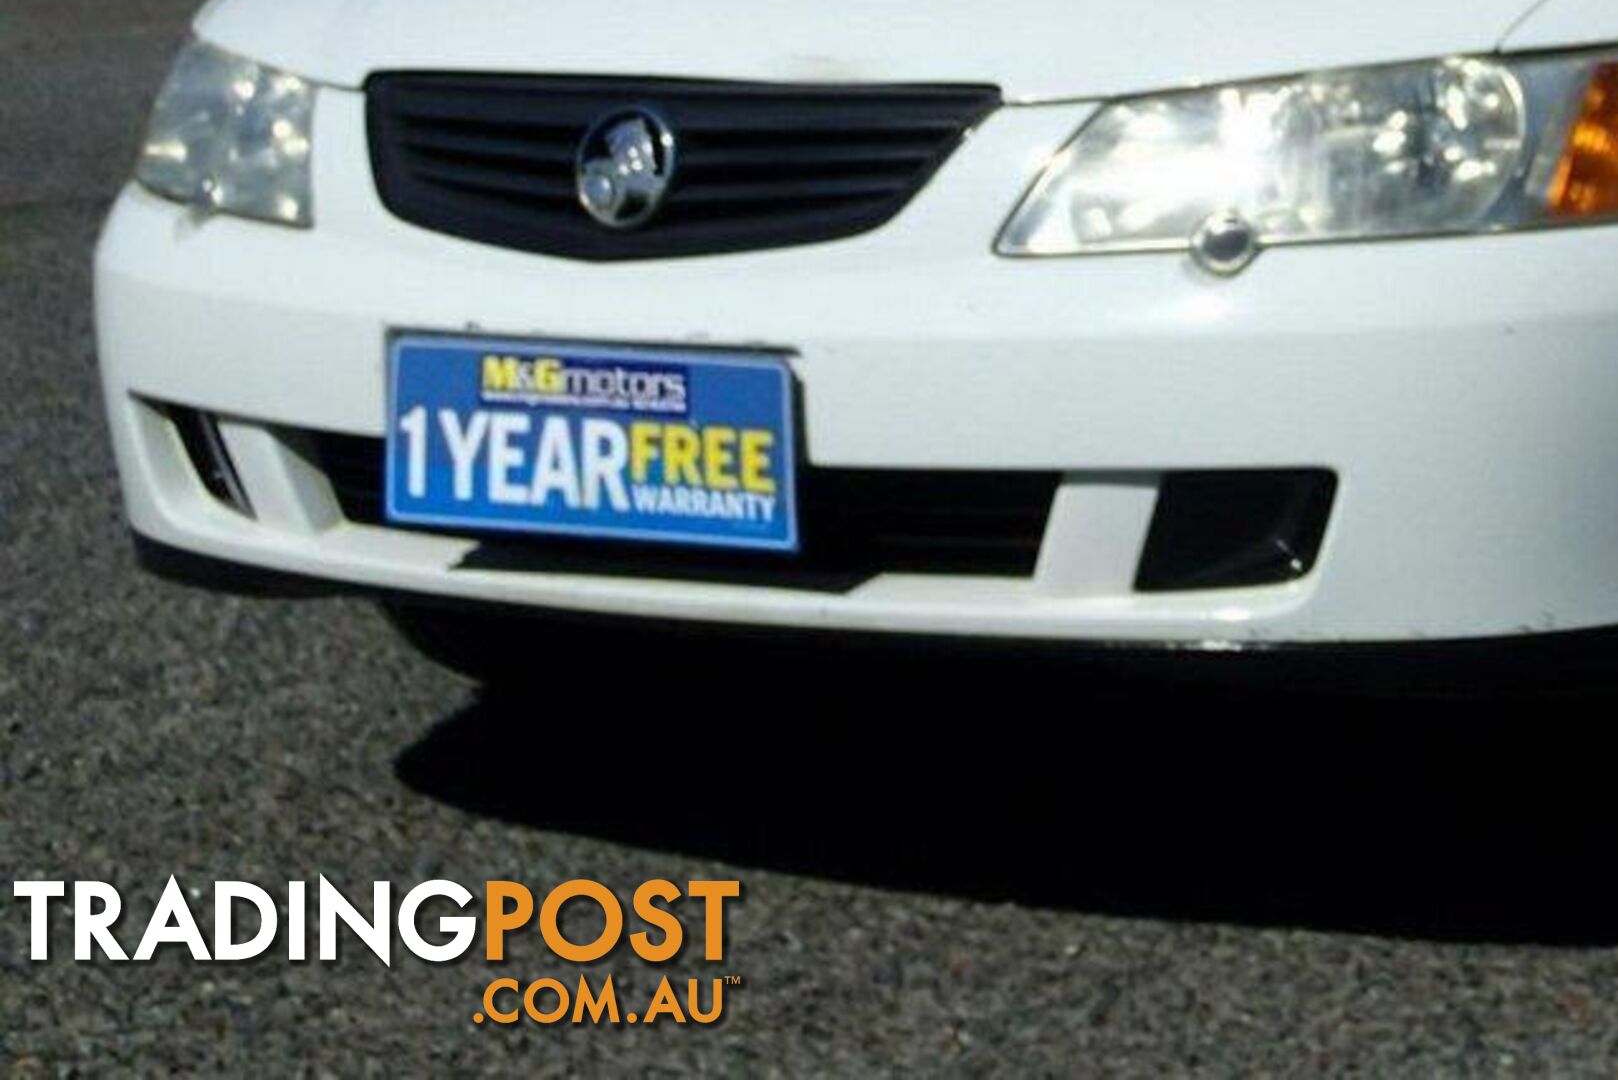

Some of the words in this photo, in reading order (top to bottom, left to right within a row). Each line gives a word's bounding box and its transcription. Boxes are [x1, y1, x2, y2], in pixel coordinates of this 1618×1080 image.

[401, 406, 429, 498] 1
[438, 408, 628, 511] YEAR
[631, 423, 774, 492] FREE
[631, 487, 776, 521] WARRANTY
